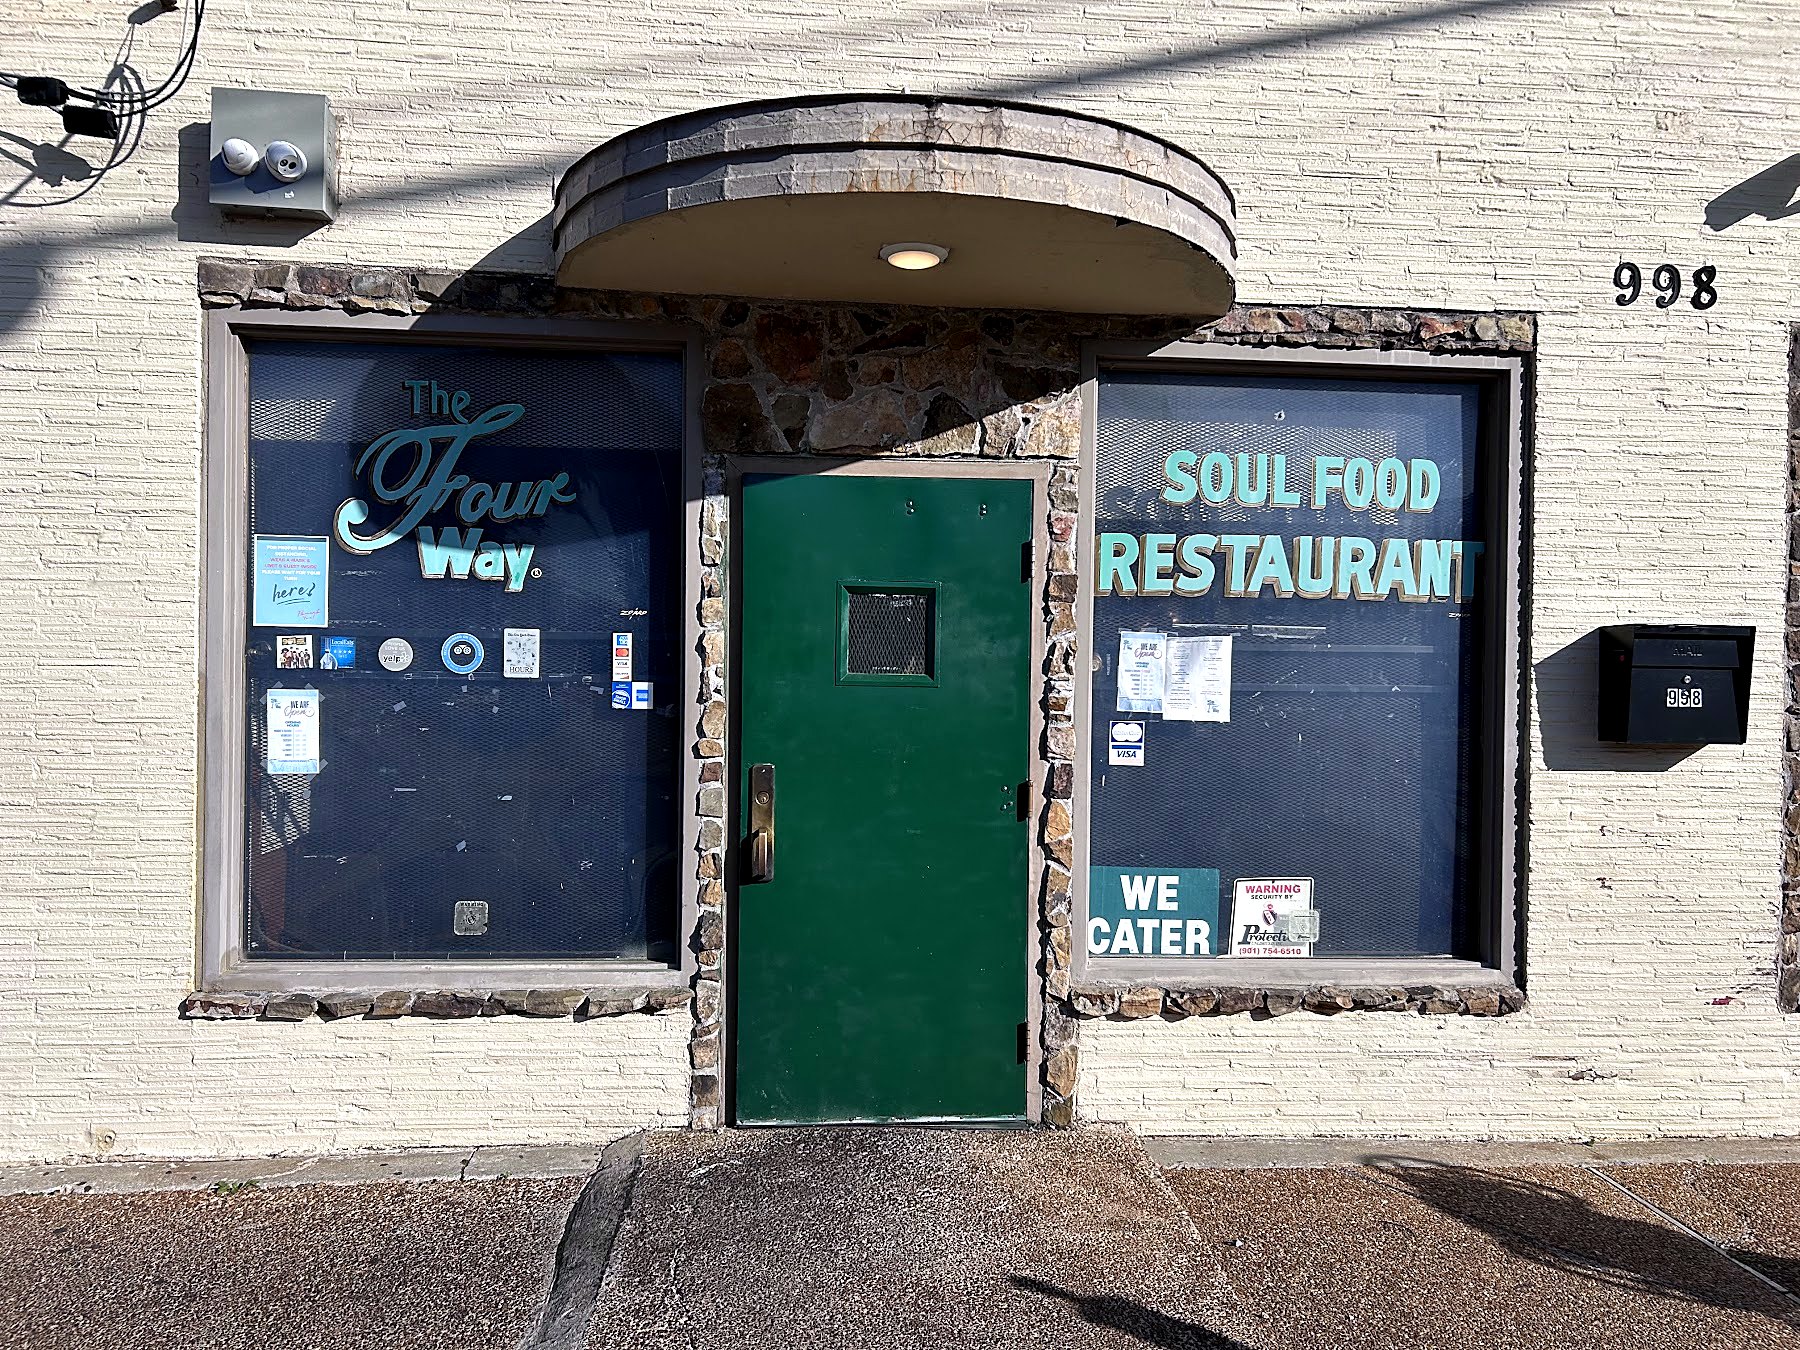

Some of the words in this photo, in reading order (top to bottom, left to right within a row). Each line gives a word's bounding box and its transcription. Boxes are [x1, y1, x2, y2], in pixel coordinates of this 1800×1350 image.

[1613, 262, 1717, 310] 998
[402, 380, 471, 424] The
[333, 403, 577, 556] Four
[1160, 450, 1300, 508] SOUL
[1311, 457, 1441, 513] FOOD
[416, 526, 535, 592] Way
[1095, 533, 1485, 603] RESTAURANT
[273, 583, 308, 602] here
[383, 655, 401, 663] yelp
[290, 700, 299, 709] WE
[300, 700, 310, 709] ARE
[1117, 750, 1137, 758] VISA
[1120, 874, 1180, 911] WE
[1245, 884, 1301, 894] WARNING
[1088, 917, 1211, 955] CATER
[1239, 947, 1260, 955] (901)
[1263, 947, 1302, 955] 754-6510
